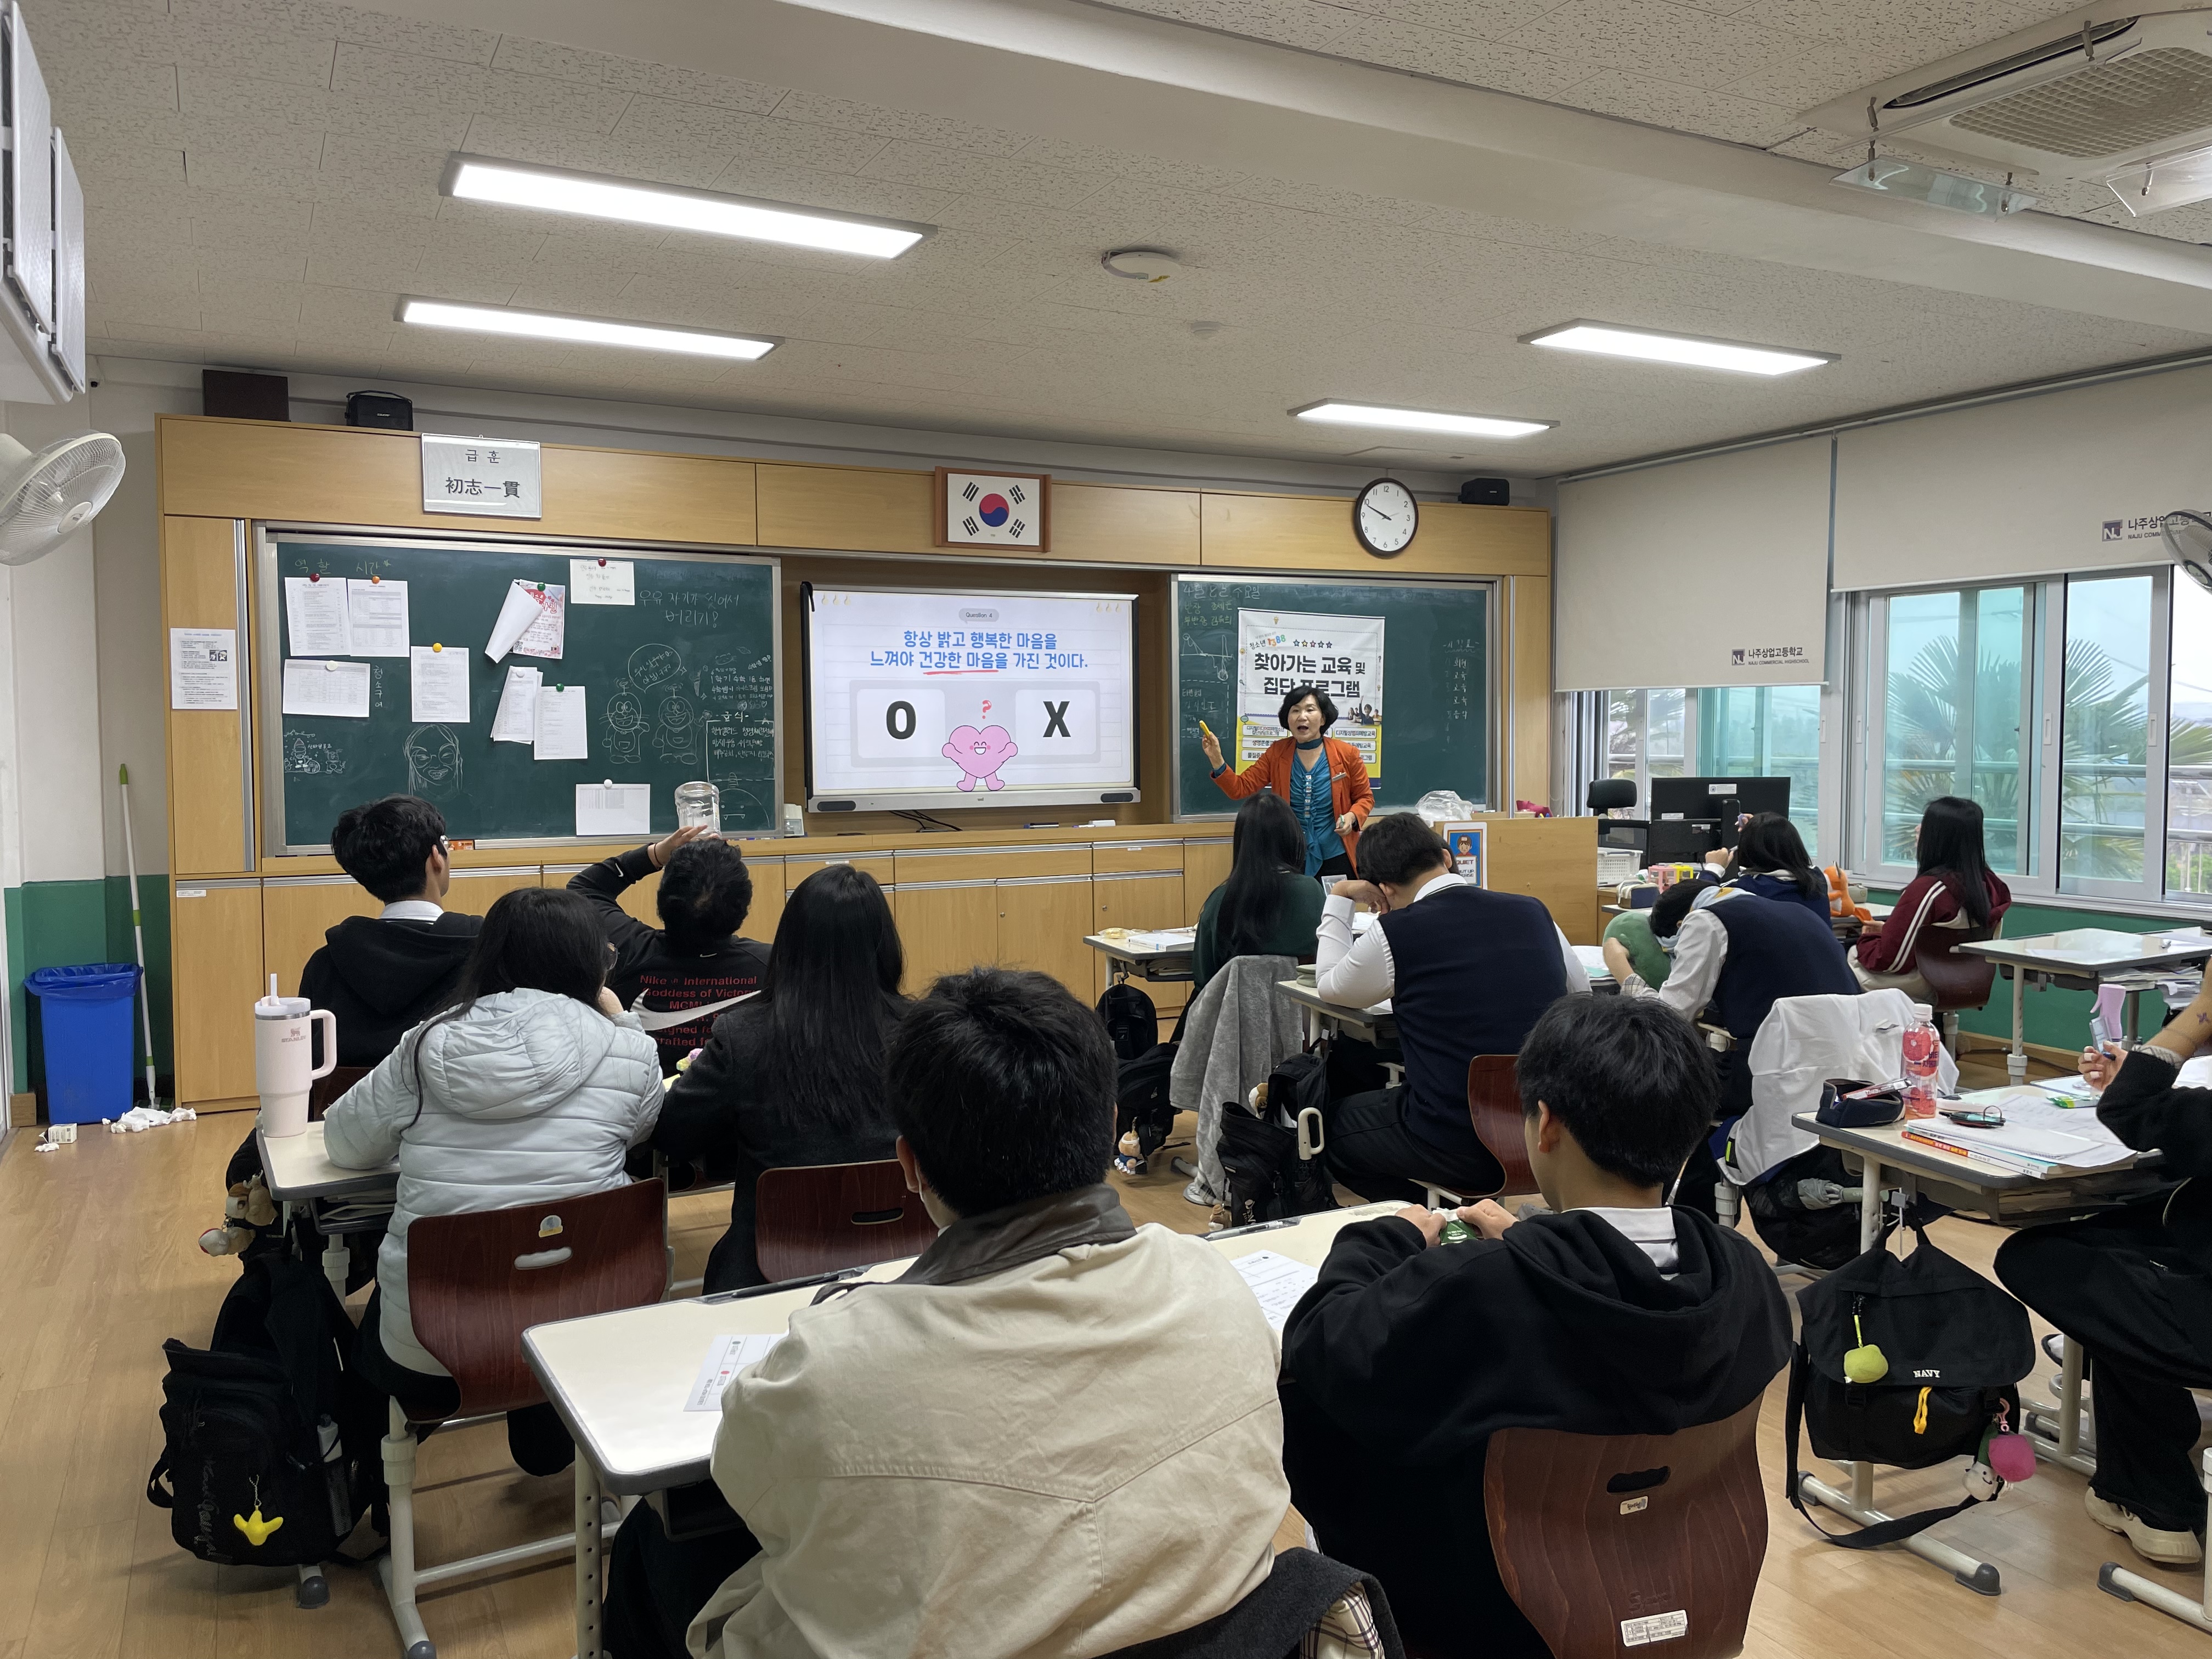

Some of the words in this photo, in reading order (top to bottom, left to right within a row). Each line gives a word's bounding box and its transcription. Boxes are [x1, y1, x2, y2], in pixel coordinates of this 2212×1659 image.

[445, 477, 520, 498] 初志一貫
[356, 560, 382, 575] 시간
[639, 590, 663, 607] 우유
[667, 591, 698, 606] 자기가
[1184, 602, 1201, 615] 반장
[665, 610, 719, 628] 버리기!
[1184, 616, 1207, 627] 부반장
[903, 630, 932, 648] 항상
[937, 630, 966, 648] 밝고
[970, 631, 1012, 650] 행복한
[1017, 633, 1058, 650] 마음을
[1249, 639, 1266, 650] 청소년
[1267, 634, 1286, 647] 1388
[870, 650, 915, 668] 느껴야
[919, 651, 962, 669] 건강한
[967, 652, 1008, 670] 마음을
[1014, 653, 1040, 670] 가진
[1045, 653, 1088, 670] 것이다.
[1748, 646, 1803, 659] 나주상업고등학교
[1254, 652, 1317, 674] 찾아가는
[1321, 656, 1352, 675] 교육
[1355, 661, 1366, 675] 및
[1263, 676, 1296, 696] 집단
[885, 700, 917, 740] O
[1043, 701, 1071, 738] X
[640, 974, 667, 985] Nike
[684, 975, 757, 986] International
[699, 989, 712, 998] of
[281, 1035, 307, 1043] STANLEY
[1912, 1369, 1941, 1378] NAVY
